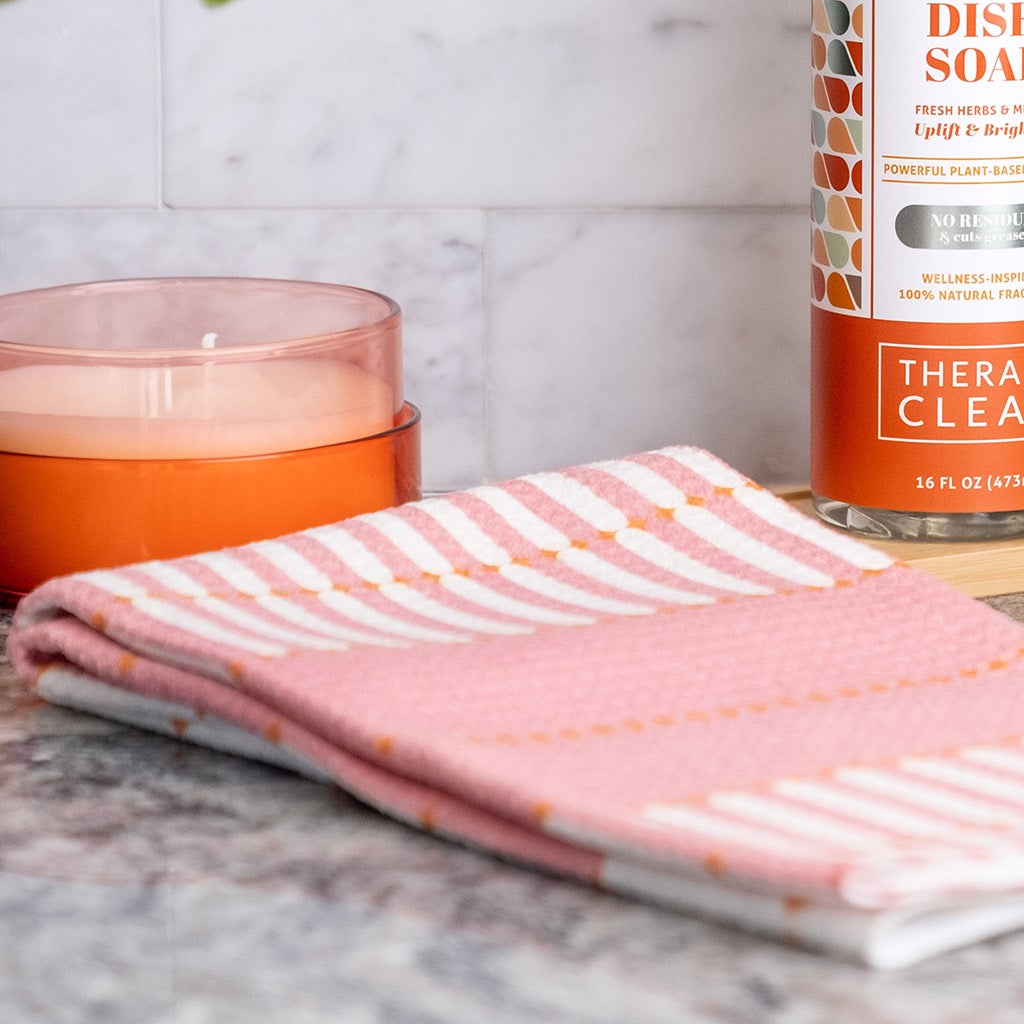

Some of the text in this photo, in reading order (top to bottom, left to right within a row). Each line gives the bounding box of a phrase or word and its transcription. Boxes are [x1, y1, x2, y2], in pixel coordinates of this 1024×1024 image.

[915, 104, 953, 116] FRESH
[957, 104, 997, 116] HERBS
[1001, 104, 1009, 116] &
[914, 122, 961, 140] Uplift
[966, 123, 979, 137] &
[883, 163, 946, 177] POWERFUL
[931, 213, 956, 228] NO
[939, 231, 950, 245] &
[953, 231, 982, 243] cuts
[899, 288, 934, 300] 100%
[939, 288, 995, 301] NATURAL
[916, 475, 935, 489] 16
[940, 476, 956, 490] FL
[961, 476, 982, 490] OZ
